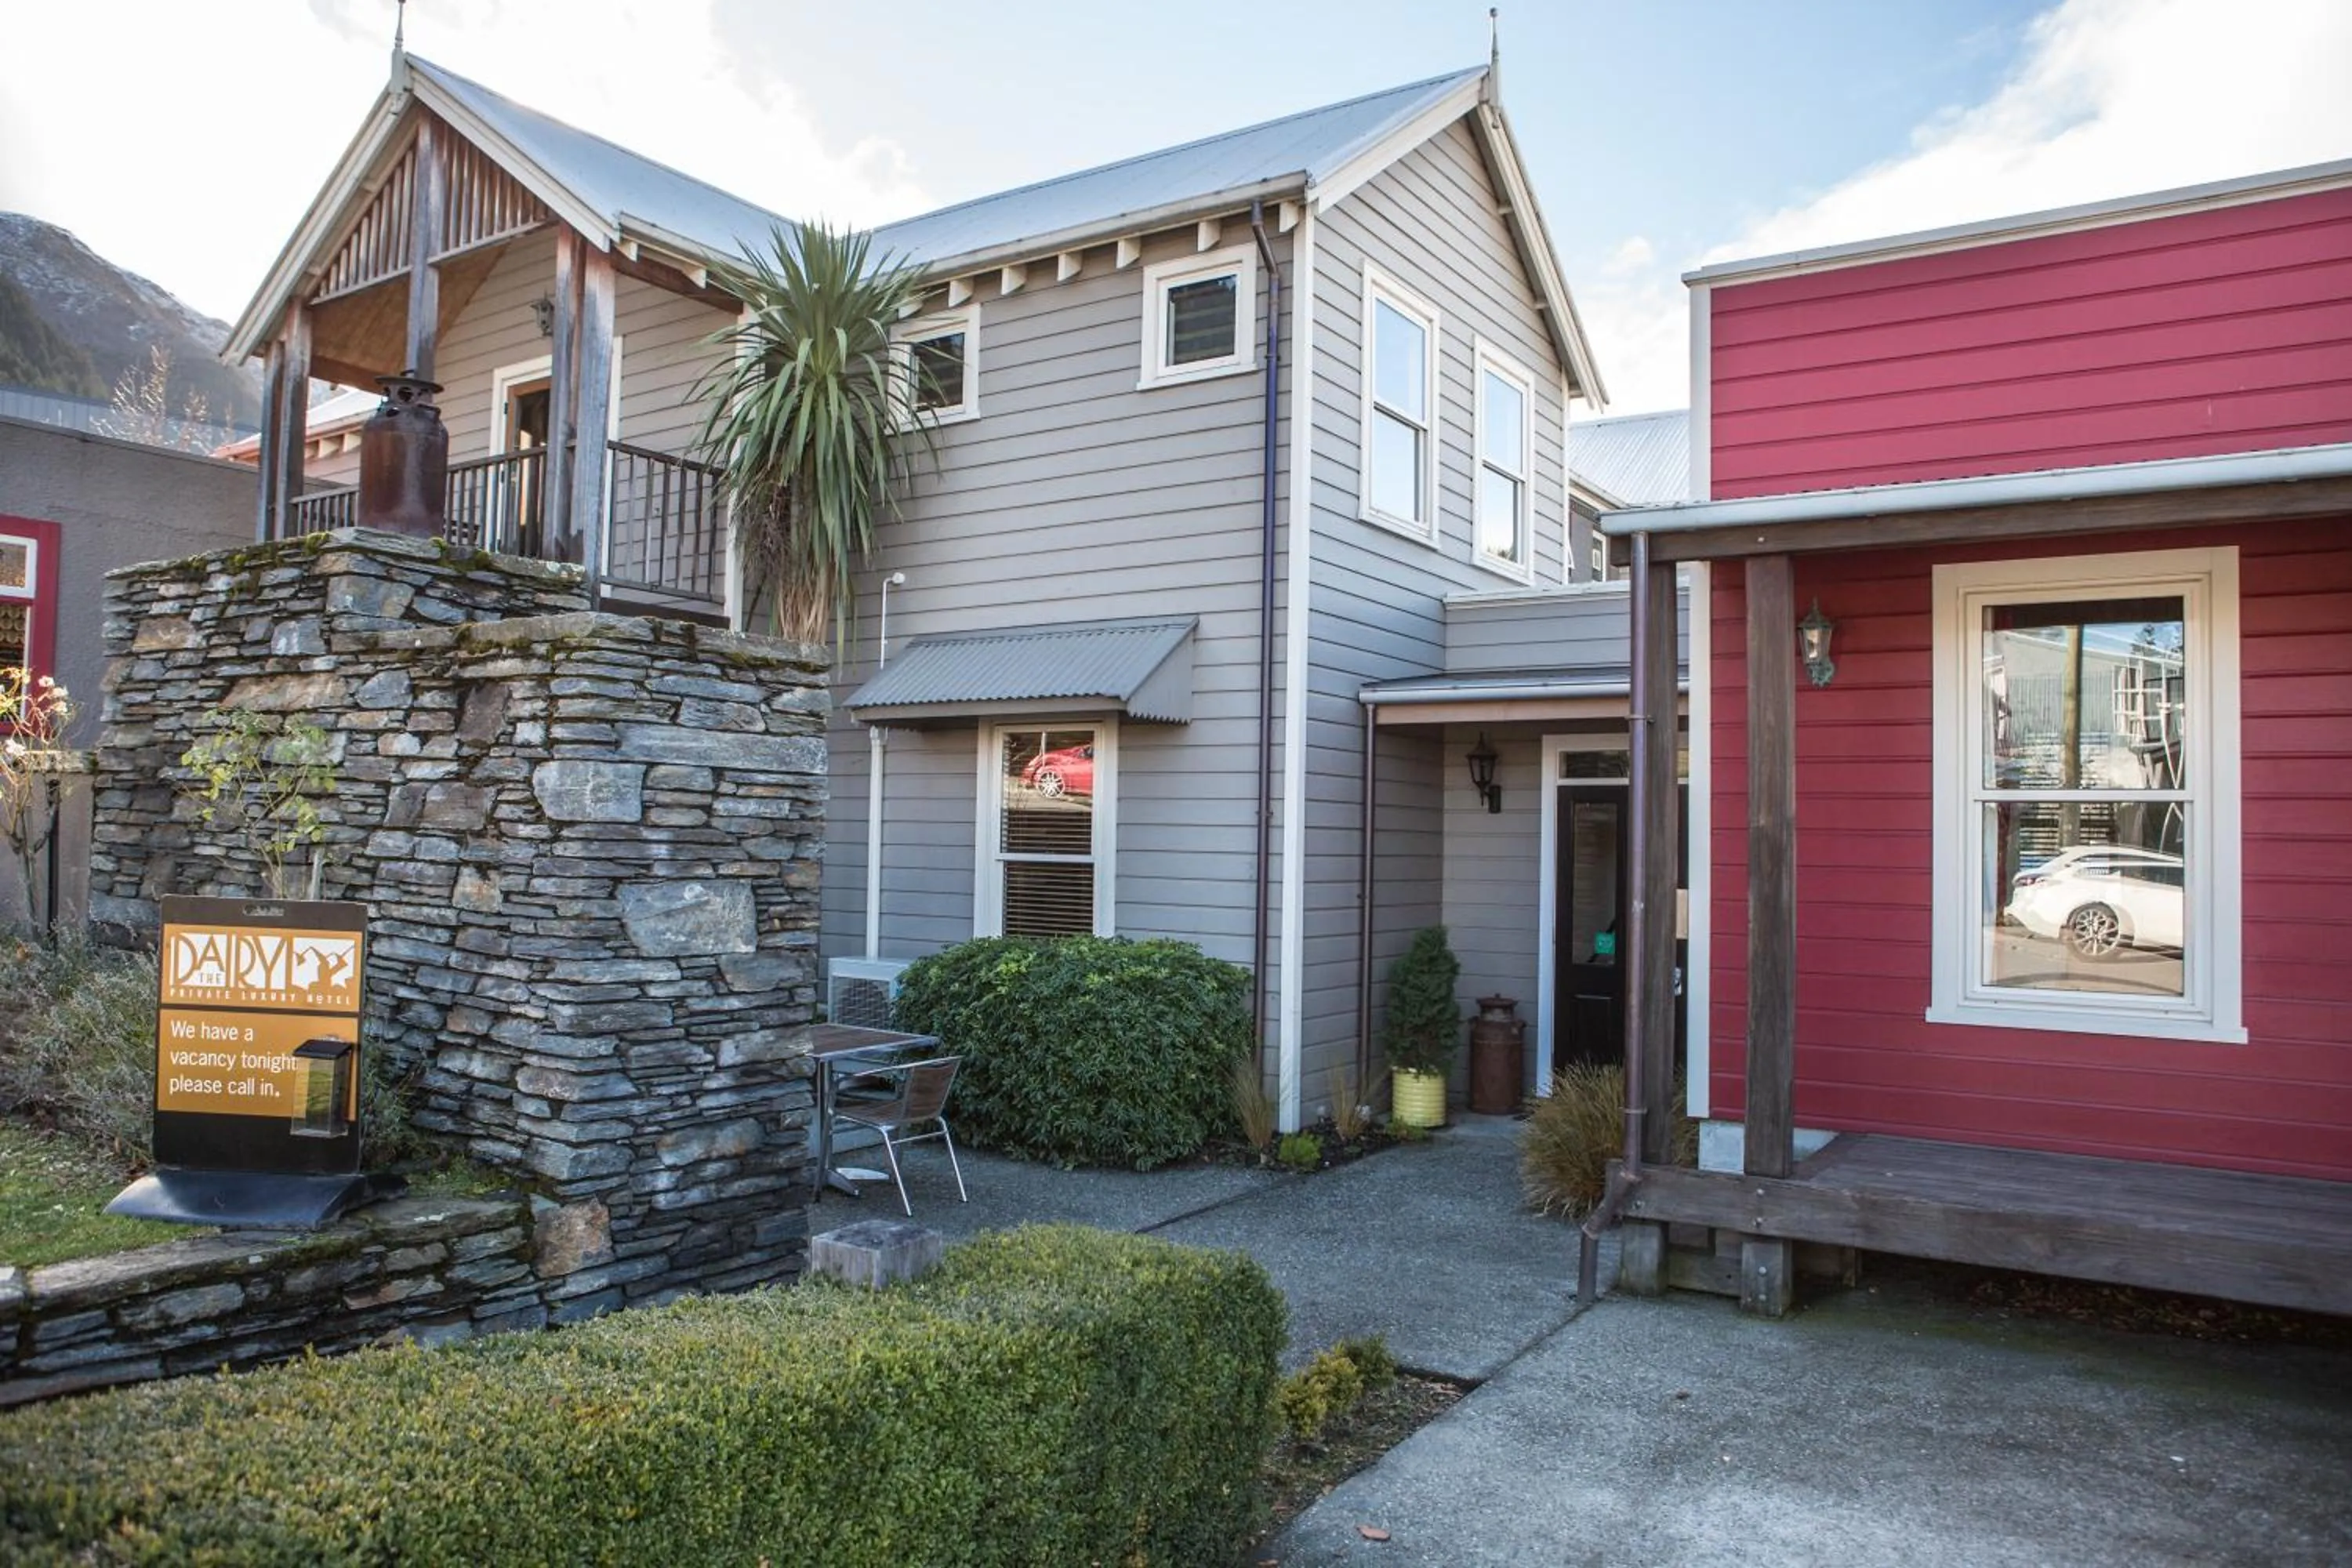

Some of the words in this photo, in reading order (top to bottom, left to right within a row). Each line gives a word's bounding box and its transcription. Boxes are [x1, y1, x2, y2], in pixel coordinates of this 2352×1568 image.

[198, 973, 222, 985] THE
[170, 989, 231, 1000] PRIVATE
[241, 993, 296, 1003] LUXURY
[170, 1020, 195, 1039] We
[201, 1022, 238, 1041] have
[244, 1028, 254, 1042] a
[169, 1051, 236, 1072] vacancy
[169, 1074, 223, 1095] please
[227, 1077, 256, 1095] call
[260, 1079, 281, 1098] in.
